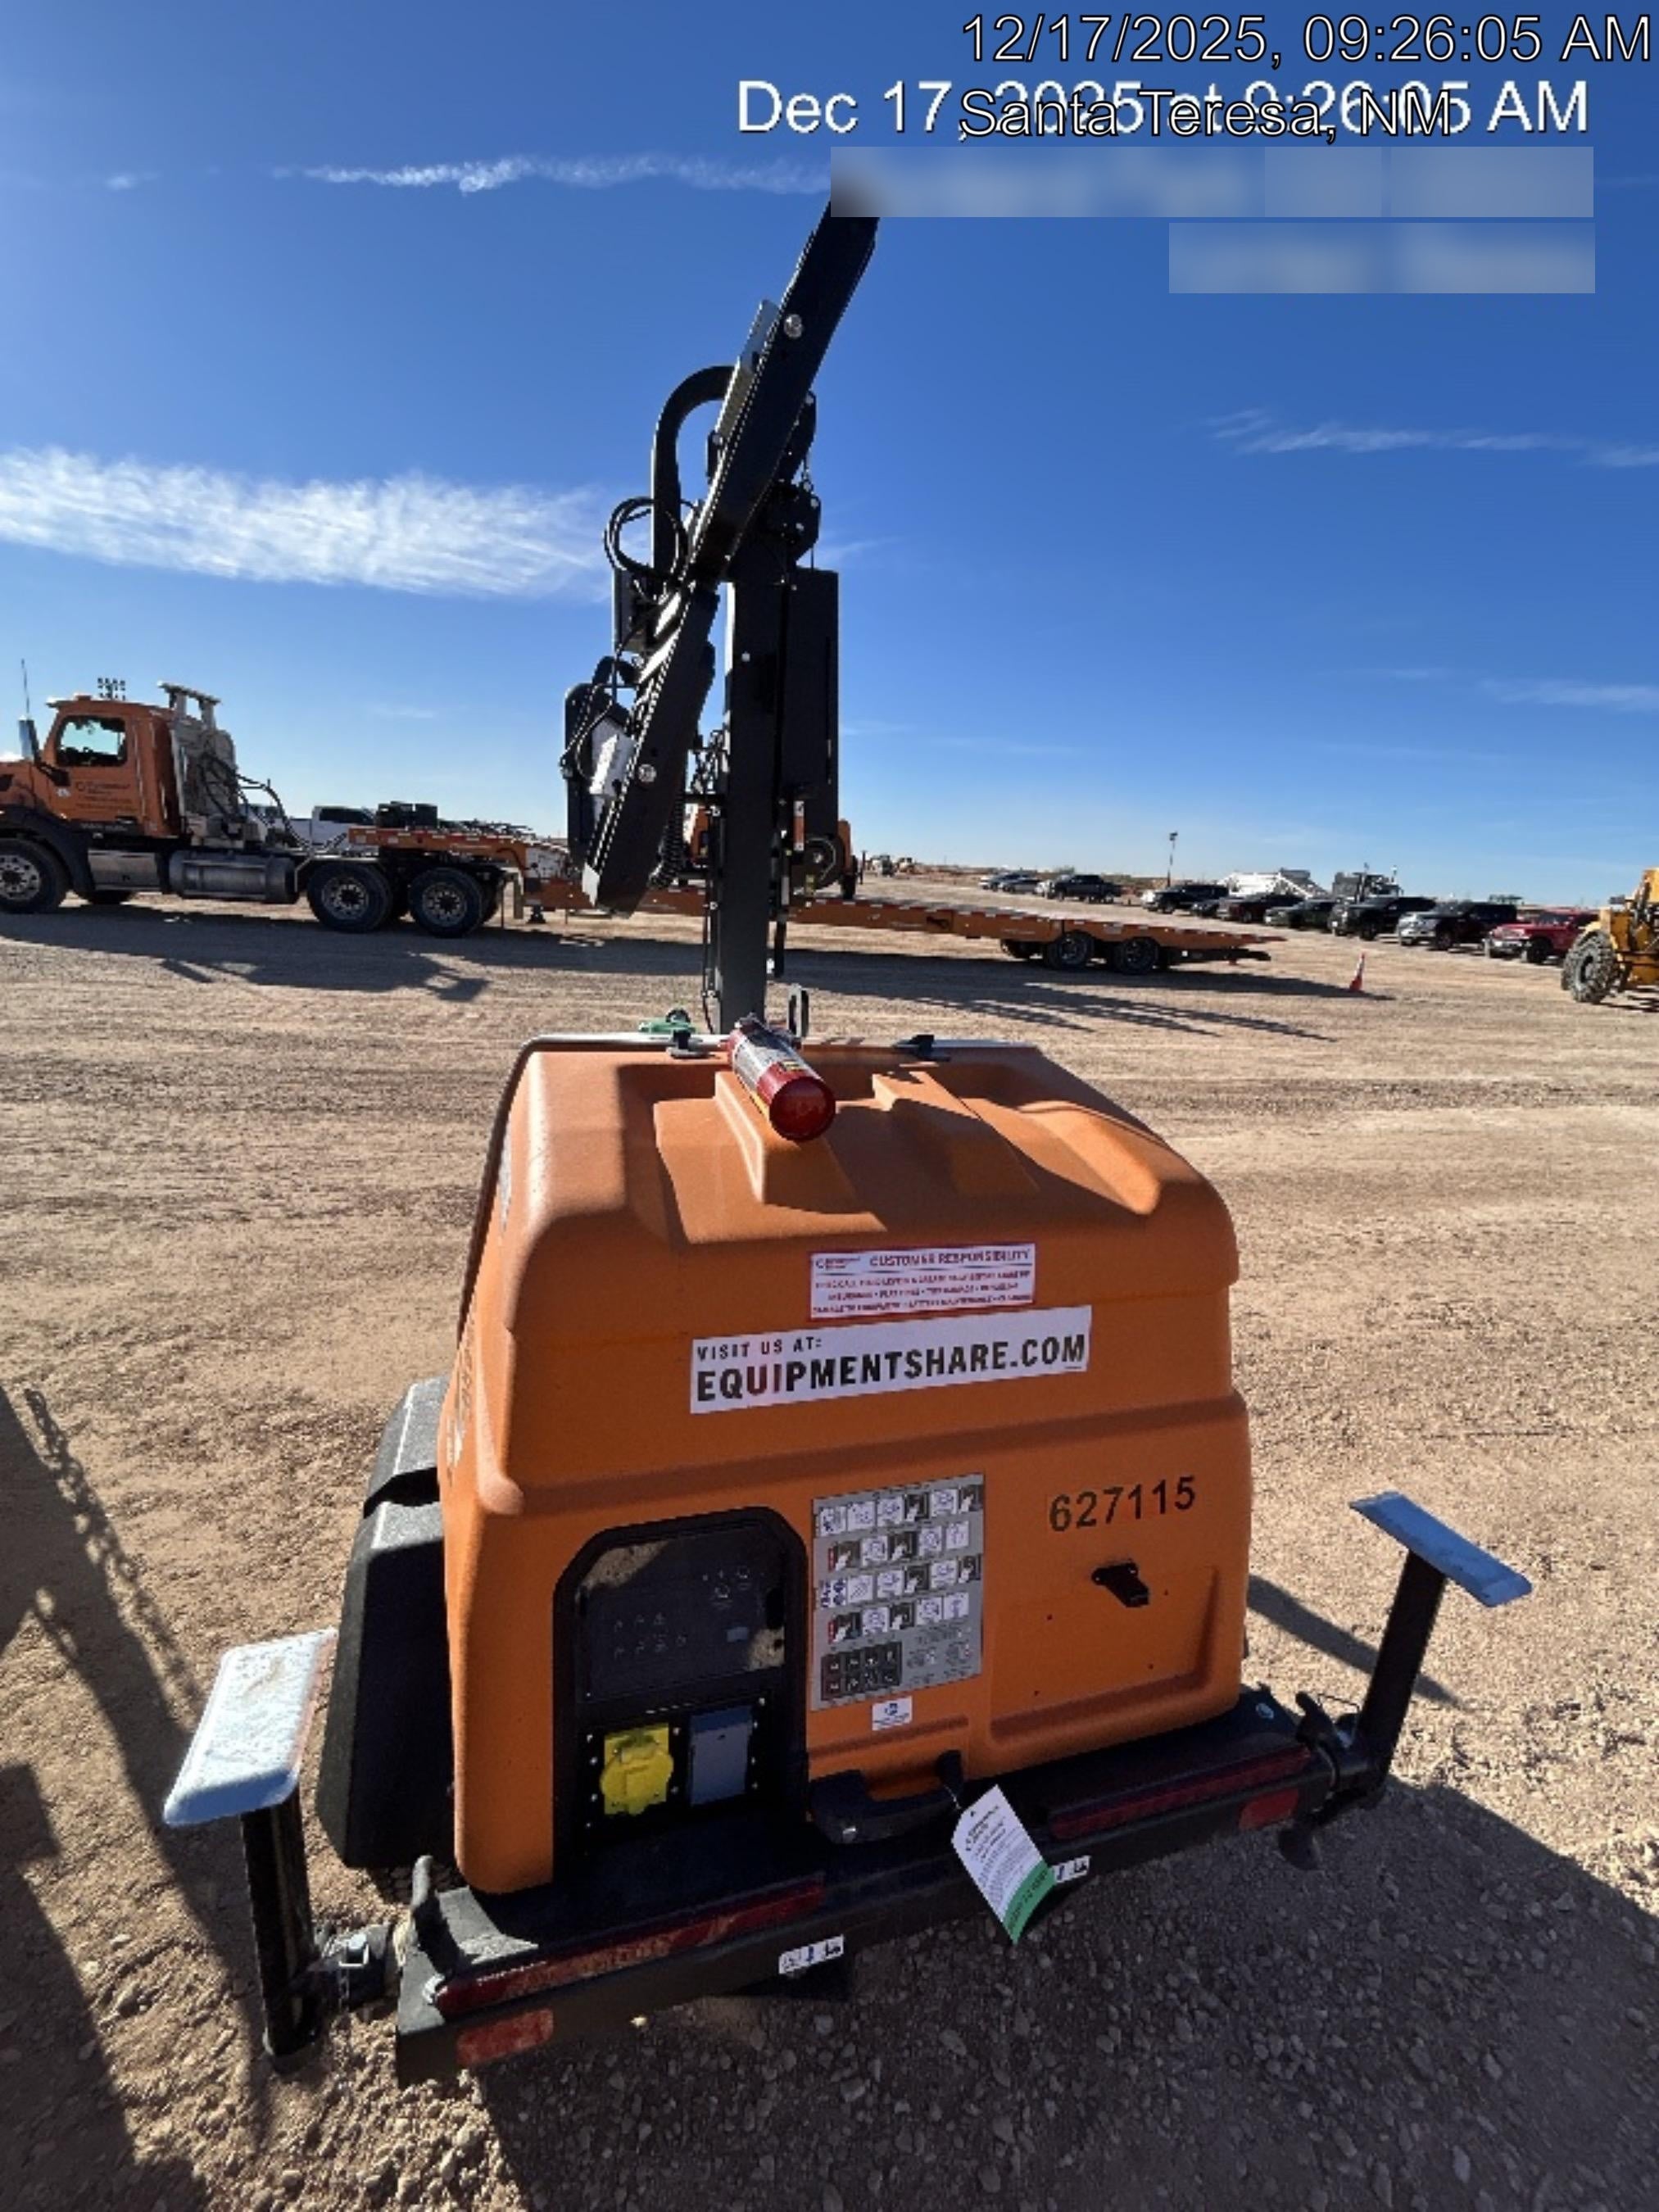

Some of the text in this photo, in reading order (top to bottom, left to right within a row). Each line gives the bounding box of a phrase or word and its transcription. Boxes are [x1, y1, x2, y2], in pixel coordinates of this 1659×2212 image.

[696, 1335, 823, 1362] VISIT US AT:
[696, 1333, 1086, 1403] EQUIPMENTSHARE.COM
[1049, 1475, 1196, 1533] 627115
